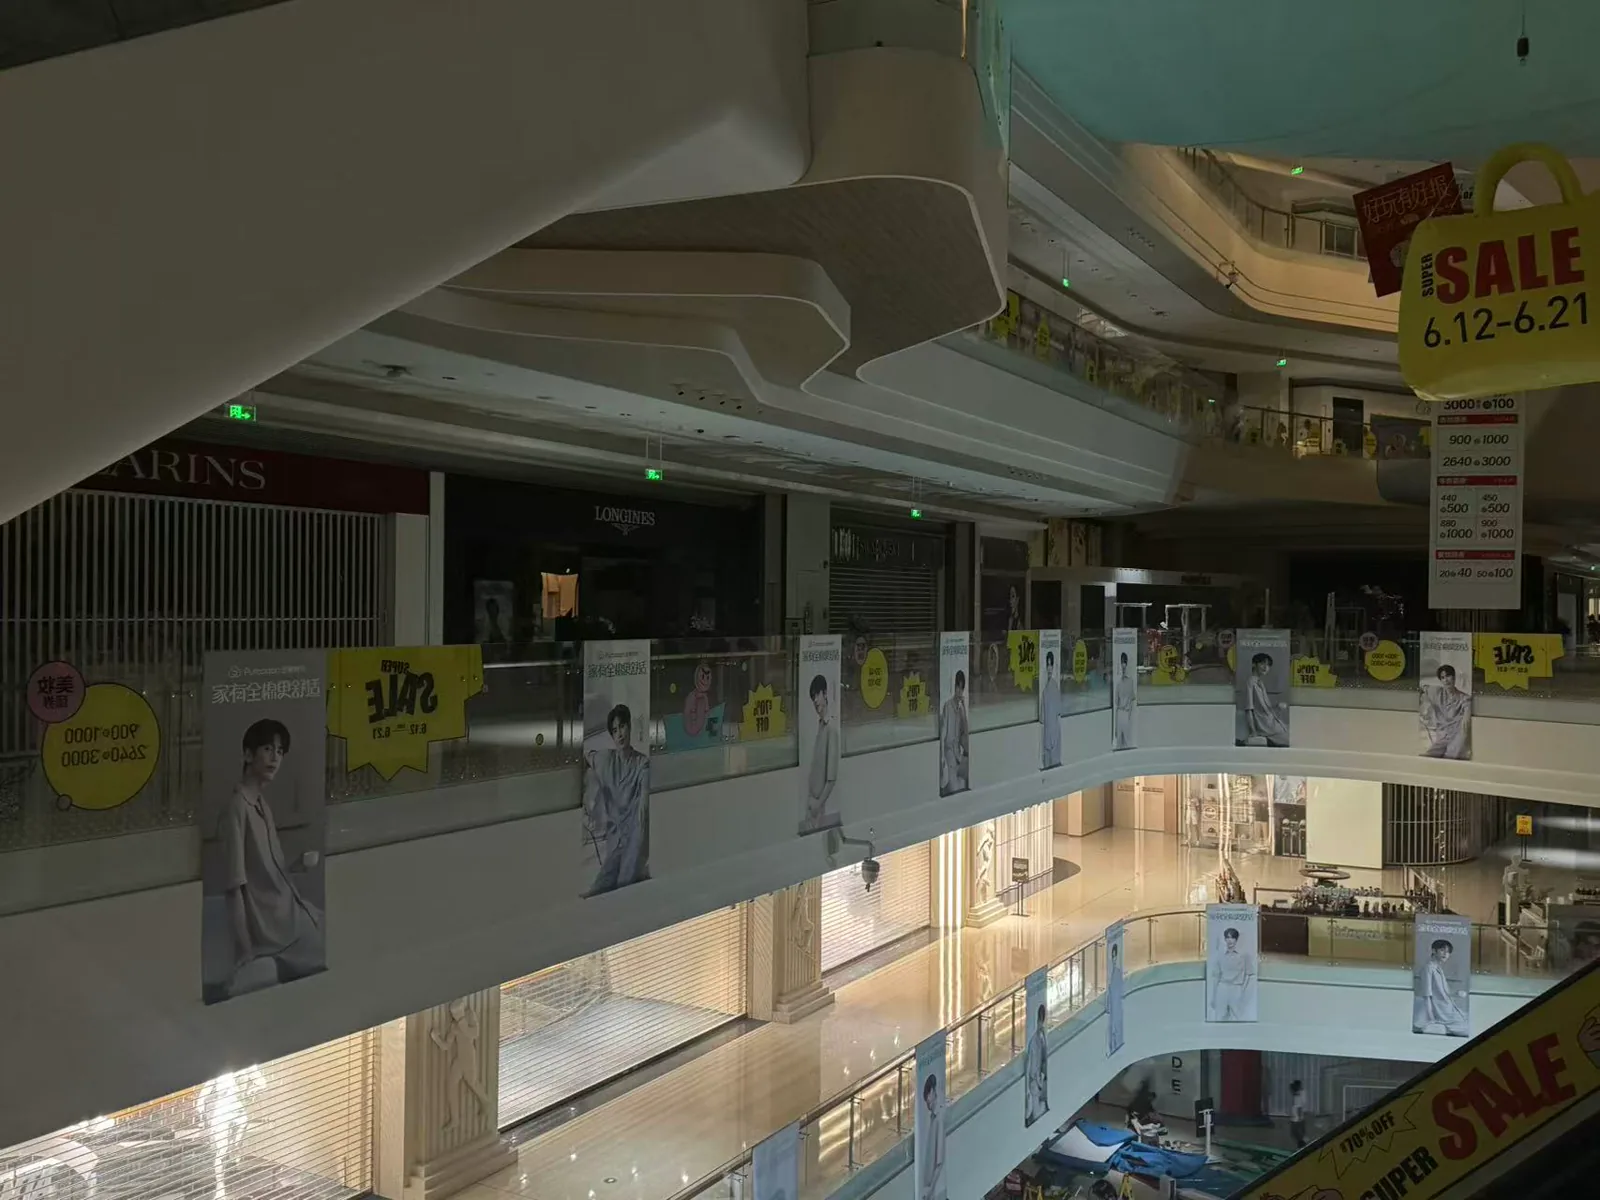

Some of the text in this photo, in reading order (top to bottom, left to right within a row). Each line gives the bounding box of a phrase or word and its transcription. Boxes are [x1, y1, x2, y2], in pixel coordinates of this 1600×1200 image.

[1361, 172, 1452, 225] 好玩有好报
[1421, 253, 1434, 297] SUPER
[1435, 227, 1585, 304] SALE
[1423, 291, 1588, 348] 6.12-6.21
[1449, 434, 1510, 445] 900 1000
[100, 448, 267, 491] ARINS
[1443, 456, 1511, 467] 2640 3000
[594, 505, 656, 526] LONGINES
[1446, 503, 1510, 513] 500 500
[1447, 529, 1514, 539] 1000 1000
[1431, 1032, 1577, 1161] SALE
